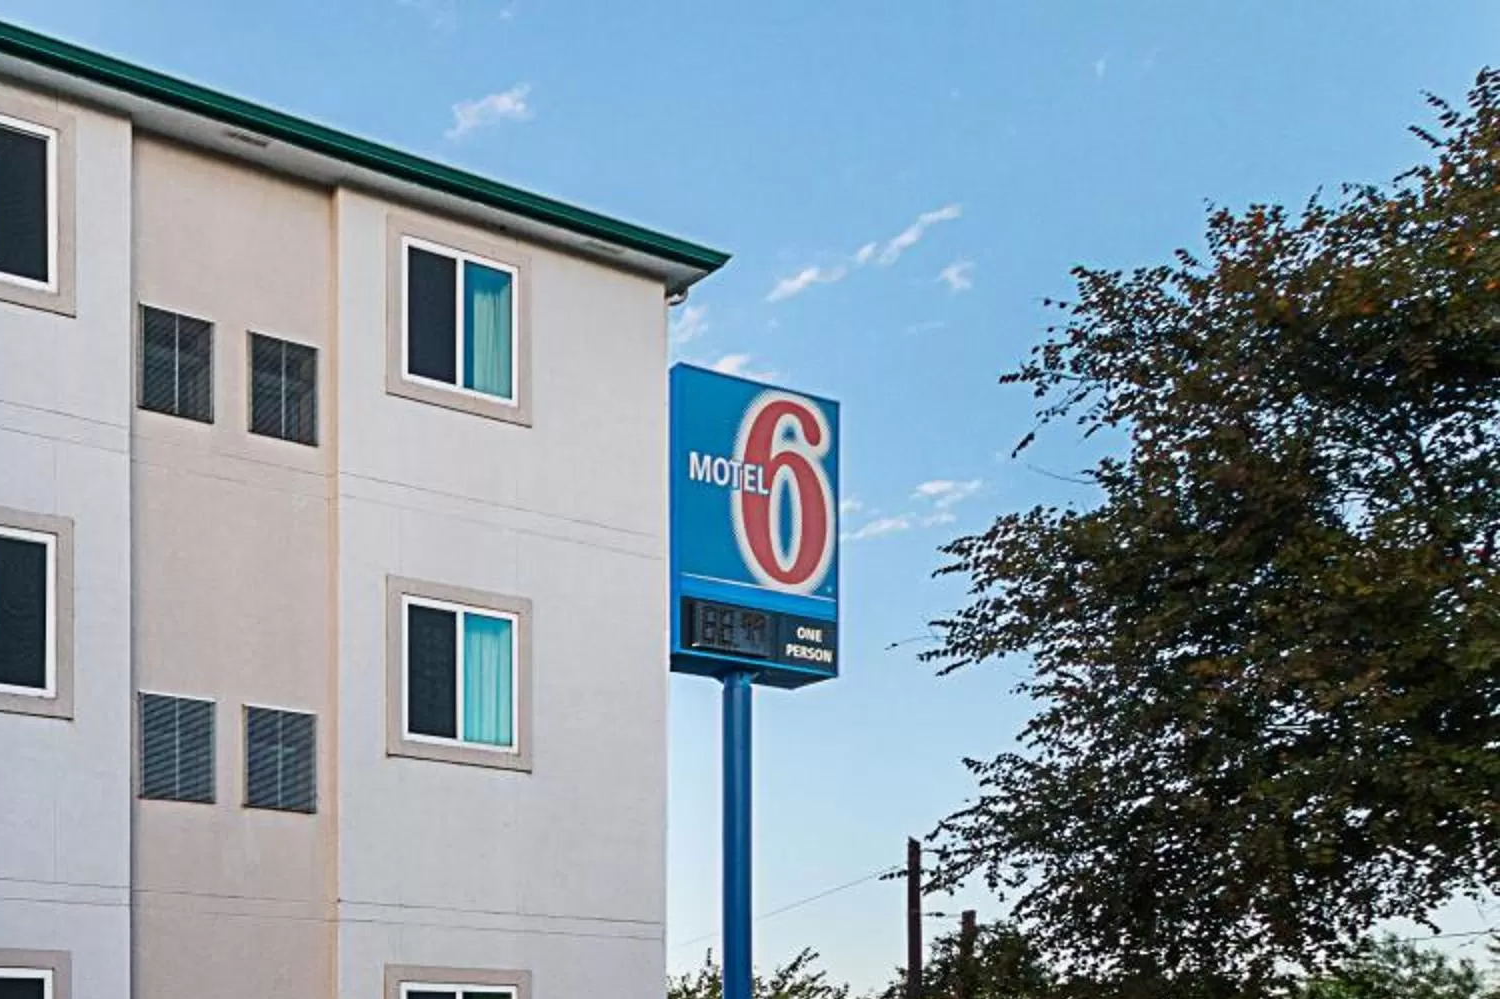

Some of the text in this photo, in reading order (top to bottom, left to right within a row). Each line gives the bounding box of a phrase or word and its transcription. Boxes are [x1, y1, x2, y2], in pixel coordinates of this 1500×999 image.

[688, 397, 829, 587] MOTEL 6
[796, 626, 823, 643] ONE
[785, 643, 833, 663] PERSON
